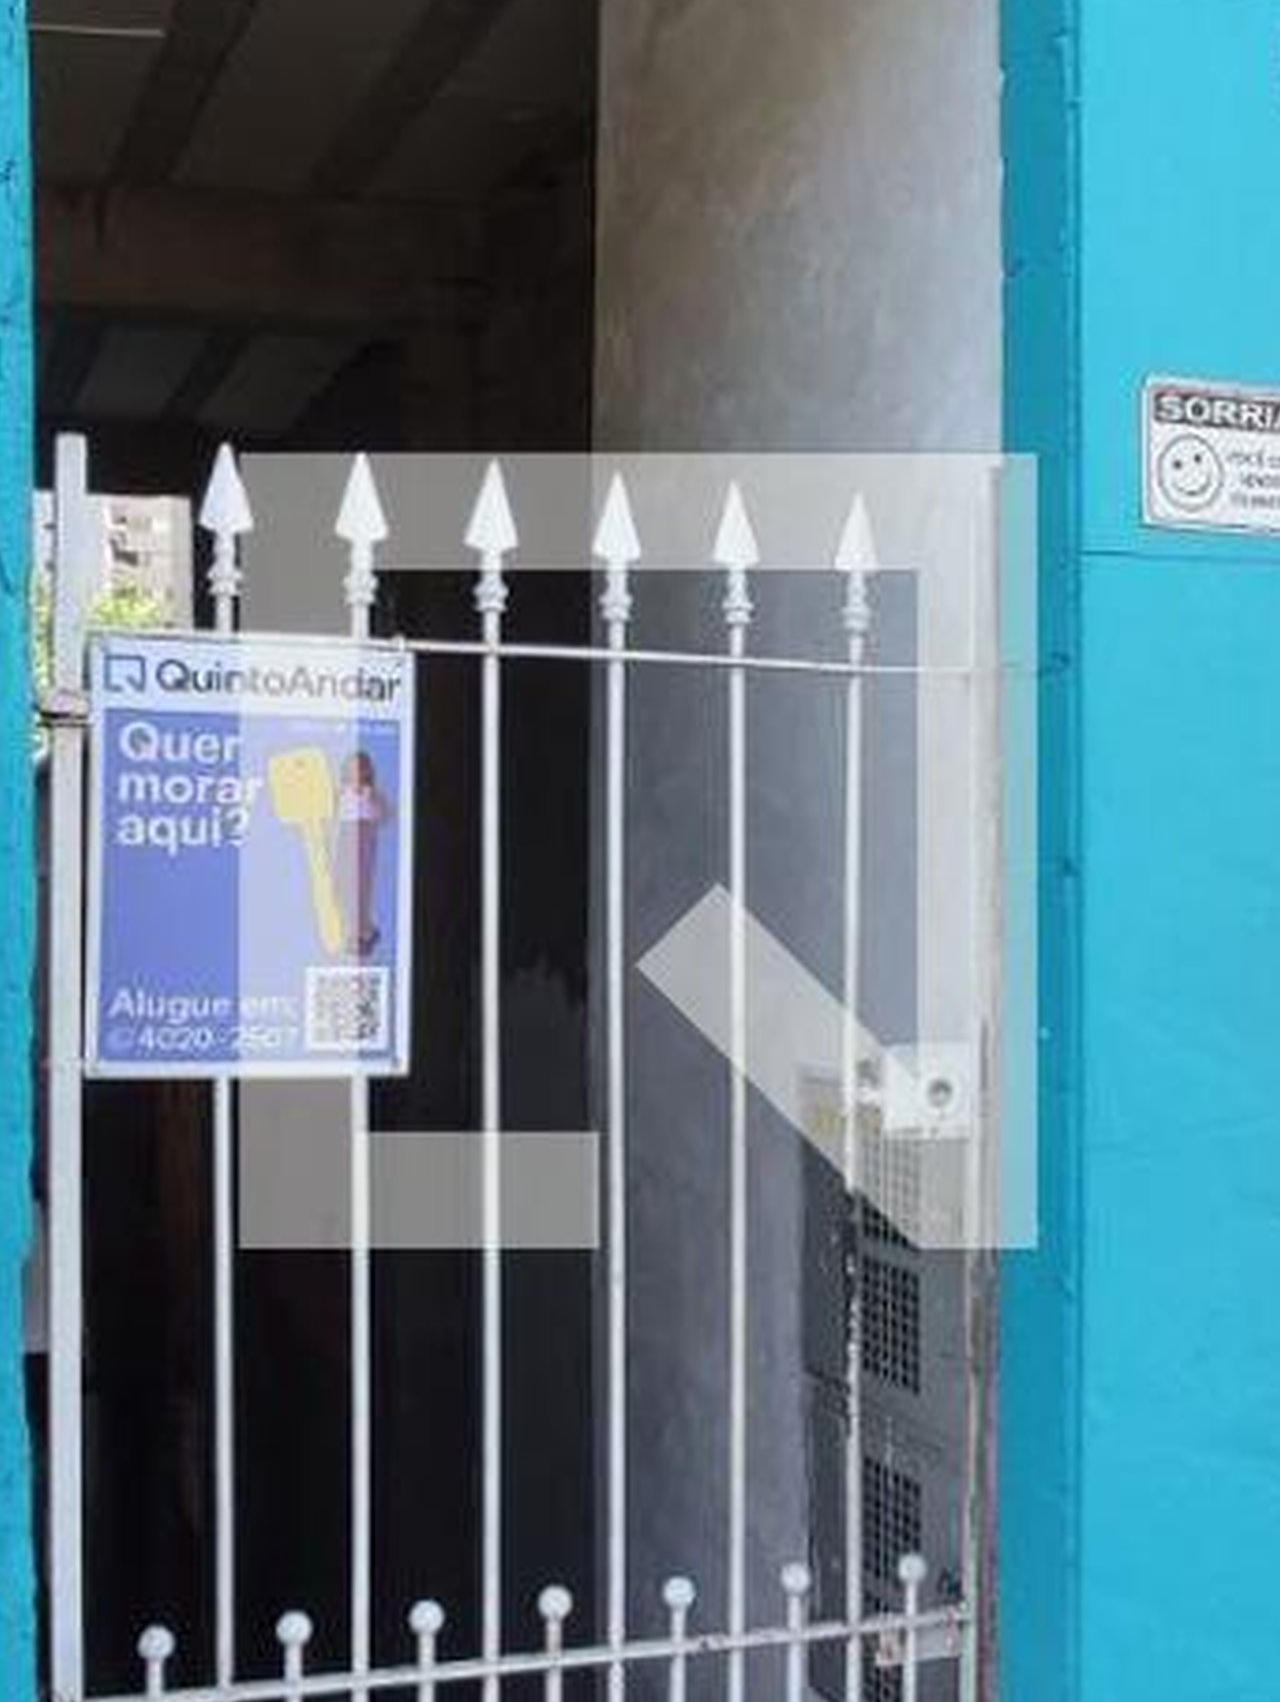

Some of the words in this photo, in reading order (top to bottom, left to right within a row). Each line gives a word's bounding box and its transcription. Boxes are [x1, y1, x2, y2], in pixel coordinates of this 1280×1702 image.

[155, 658, 402, 701] QuintoAndar
[119, 720, 242, 763] Quer
[118, 771, 263, 804] morar
[116, 808, 252, 855] aqui?
